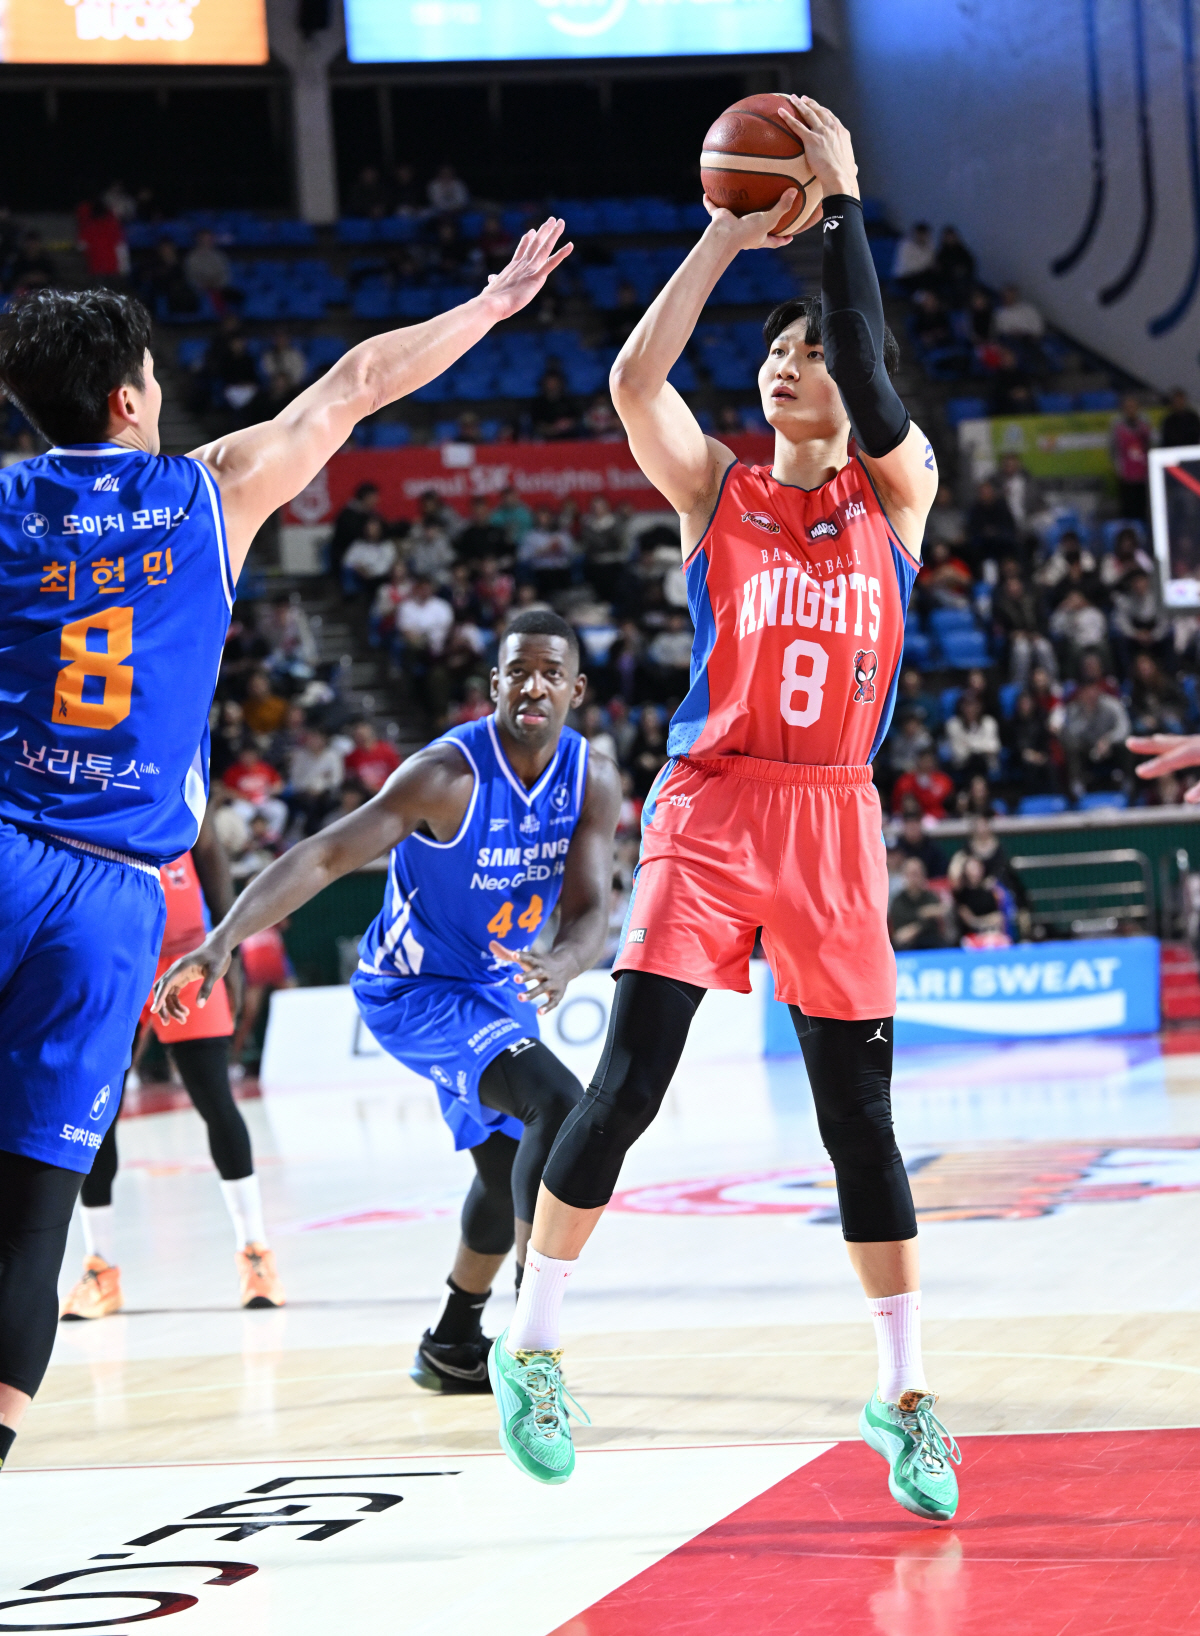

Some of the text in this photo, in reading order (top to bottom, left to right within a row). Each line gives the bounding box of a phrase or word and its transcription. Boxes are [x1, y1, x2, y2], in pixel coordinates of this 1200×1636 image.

[75, 3, 194, 41] BUCKS
[93, 474, 119, 492] KBL
[62, 506, 190, 537] 도이치 모터스
[739, 566, 881, 643] KNIGHTS
[51, 606, 134, 731] 8
[780, 638, 830, 728] 8
[14, 740, 161, 791] 보라톡스 talks
[470, 872, 511, 891] Neo
[486, 894, 543, 939] 44
[896, 957, 1121, 1001] ARI SWEAT
[0, 1469, 464, 1636] LGE.CO
